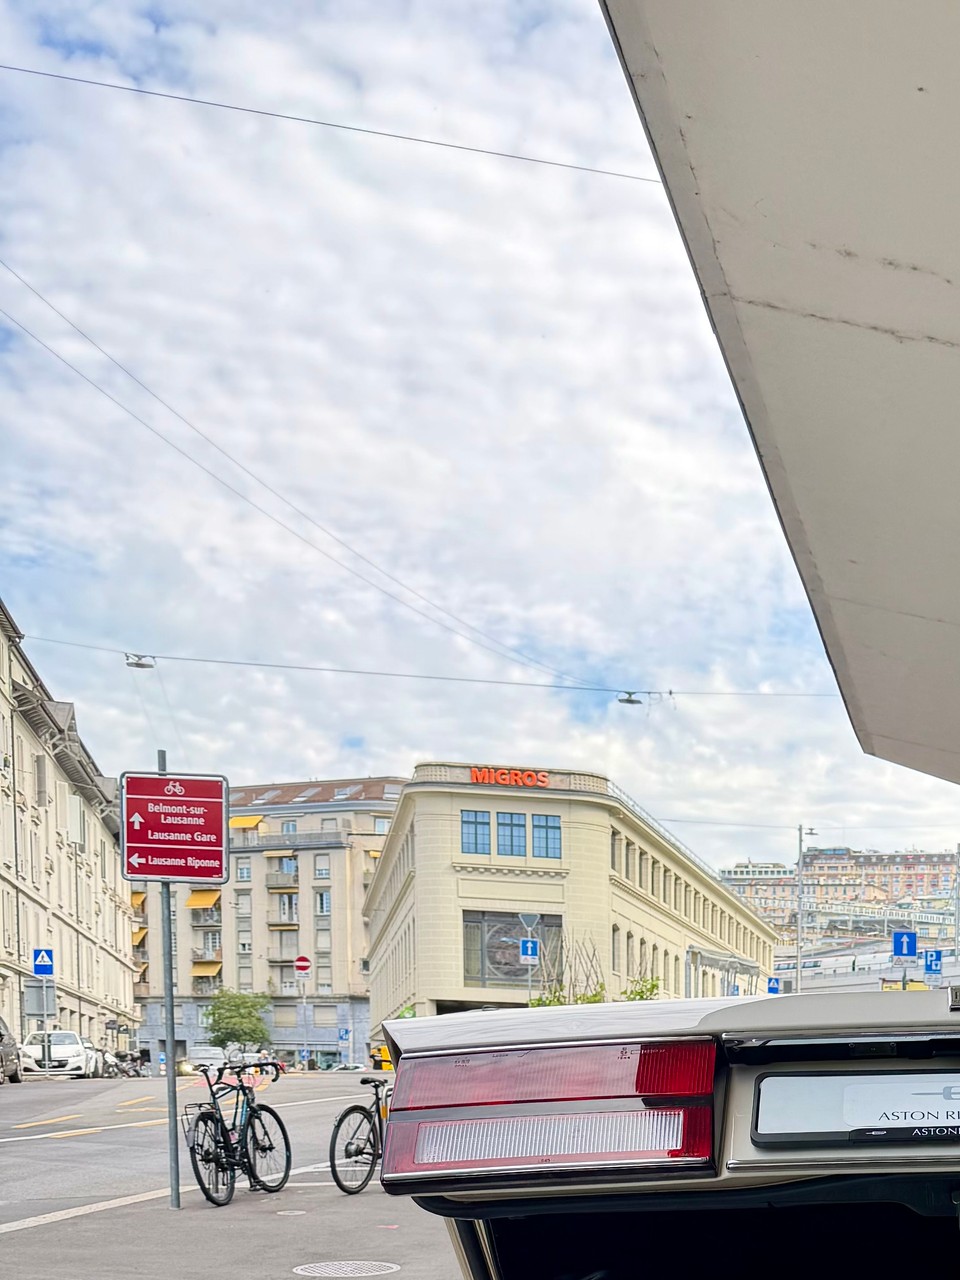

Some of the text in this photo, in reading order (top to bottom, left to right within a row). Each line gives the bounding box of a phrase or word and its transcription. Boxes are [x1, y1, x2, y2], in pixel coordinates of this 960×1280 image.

[471, 767, 549, 788] MIGROS
[148, 803, 208, 814] Belmont-sur-
[161, 814, 205, 825] Lausanne
[148, 830, 217, 842] Lausanne Gare
[148, 855, 220, 869] Lausanne Riponne
[927, 951, 936, 965] P
[878, 1110, 940, 1121] ASTON
